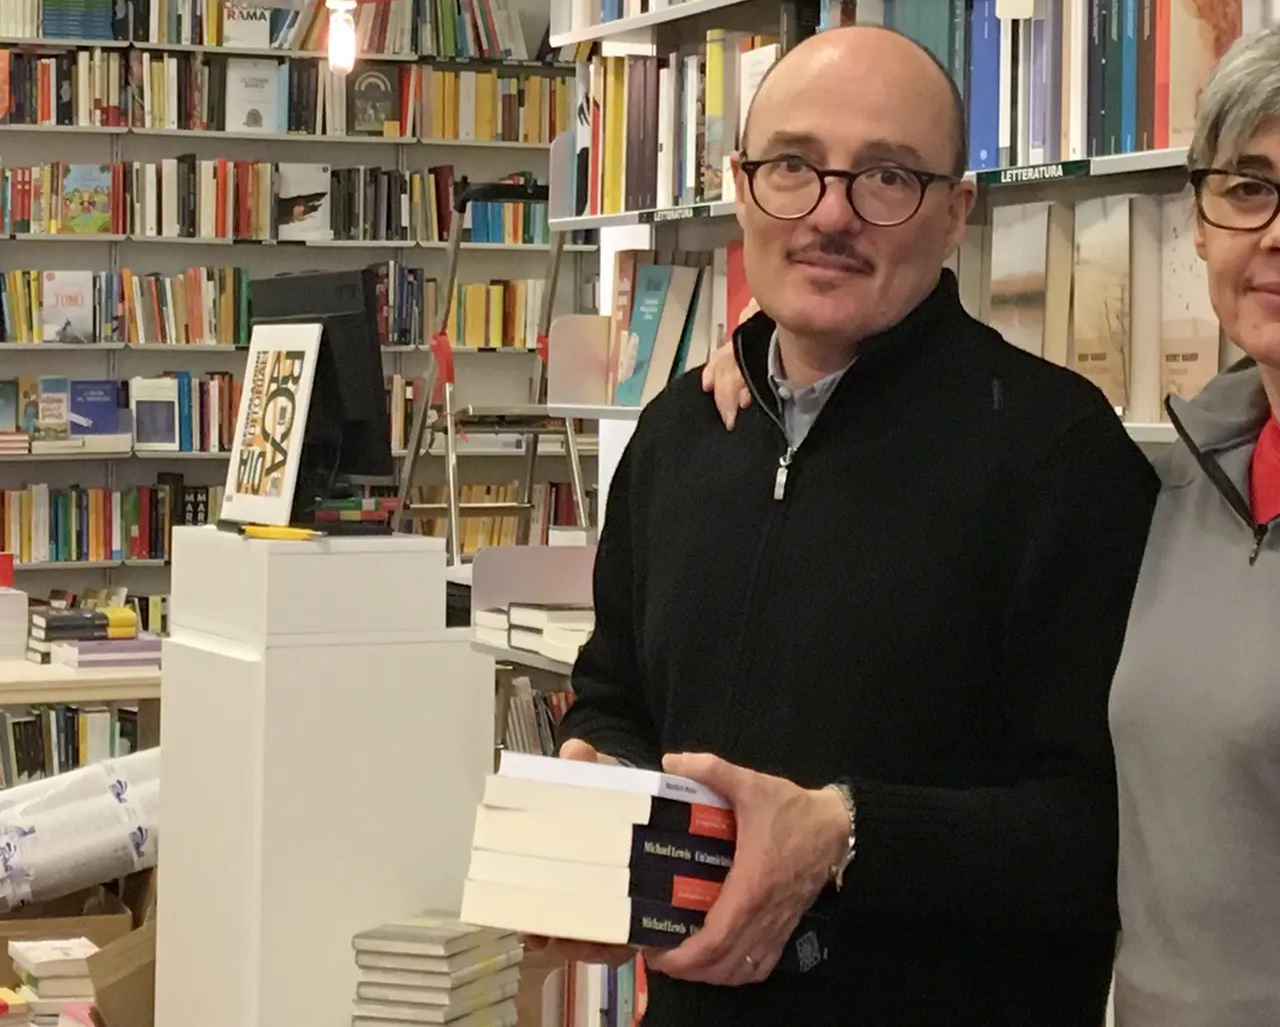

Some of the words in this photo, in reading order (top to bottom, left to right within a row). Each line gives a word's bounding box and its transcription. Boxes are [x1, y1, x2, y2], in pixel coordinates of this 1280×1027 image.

[227, 10, 268, 22] RAMA
[1001, 164, 1064, 183] LETTERATURA
[644, 841, 672, 858] Michael
[671, 846, 692, 861] Lewis
